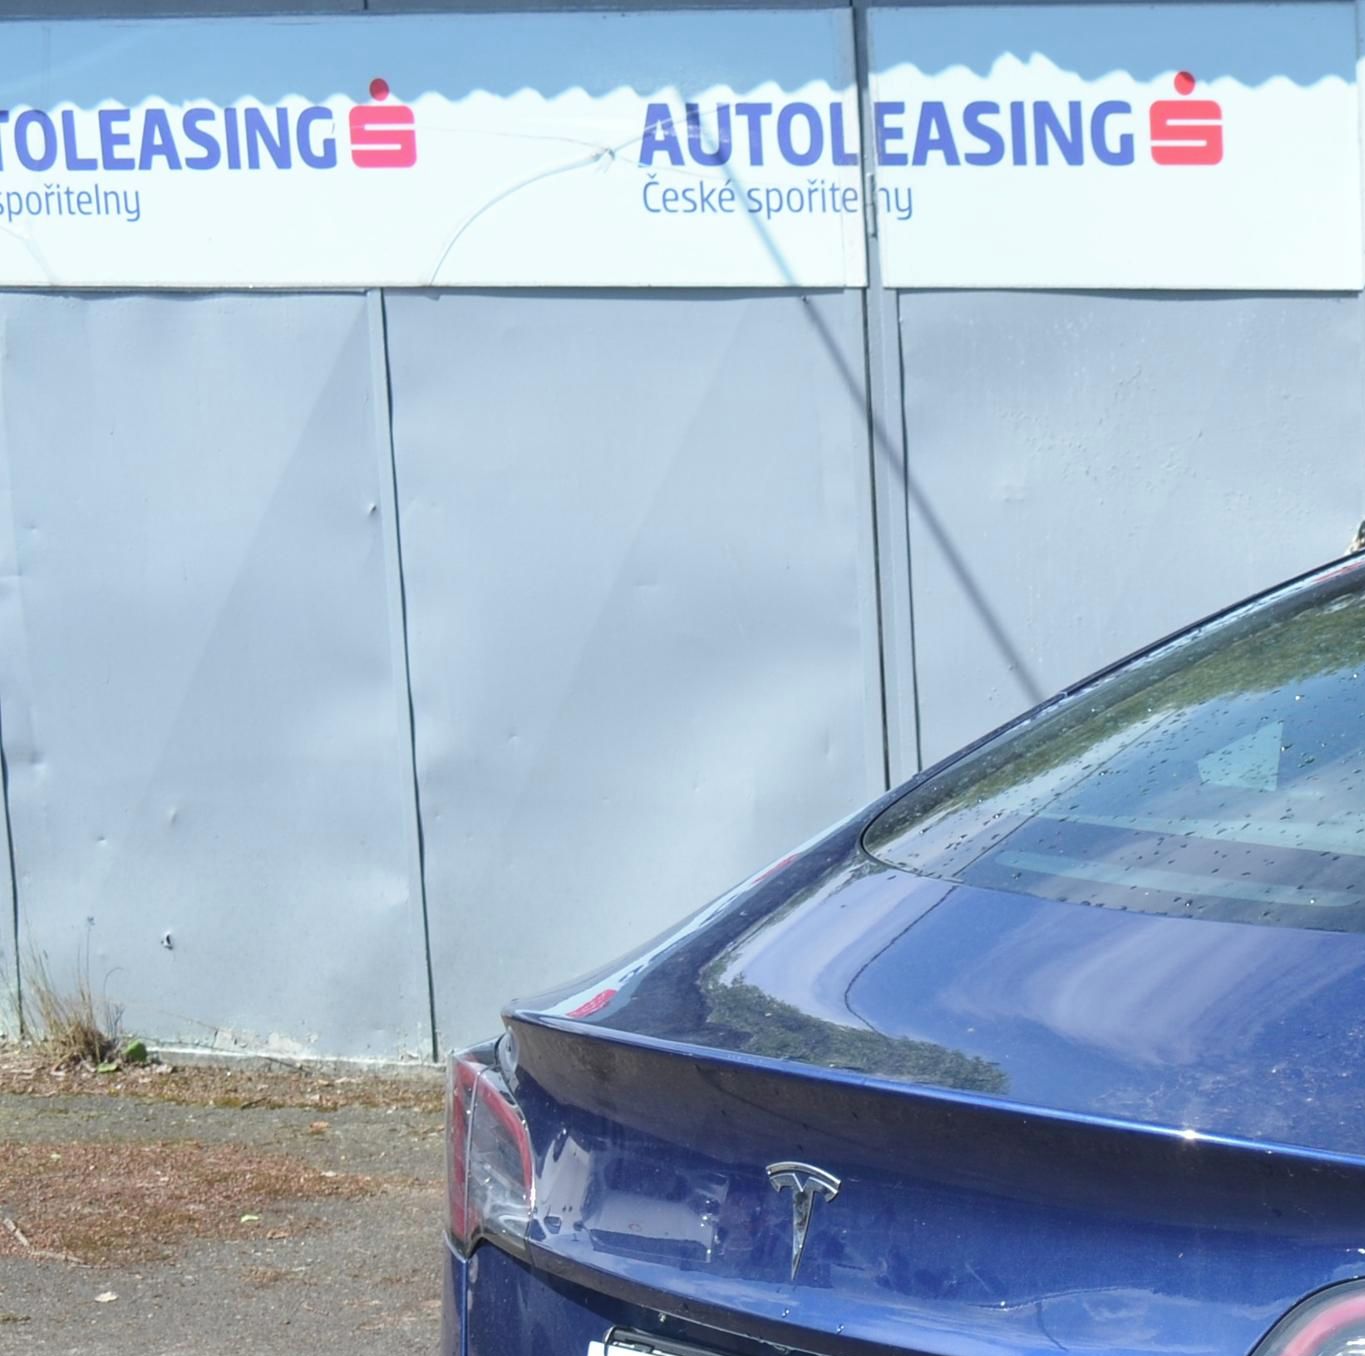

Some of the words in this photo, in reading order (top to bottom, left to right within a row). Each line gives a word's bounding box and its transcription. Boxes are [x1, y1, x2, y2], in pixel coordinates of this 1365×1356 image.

[0, 108, 336, 171] OLEASING
[638, 100, 1135, 168] AUTOLEASING
[0, 183, 141, 222] pořitelny
[642, 173, 735, 214] České
[746, 179, 913, 221] spořiteny
